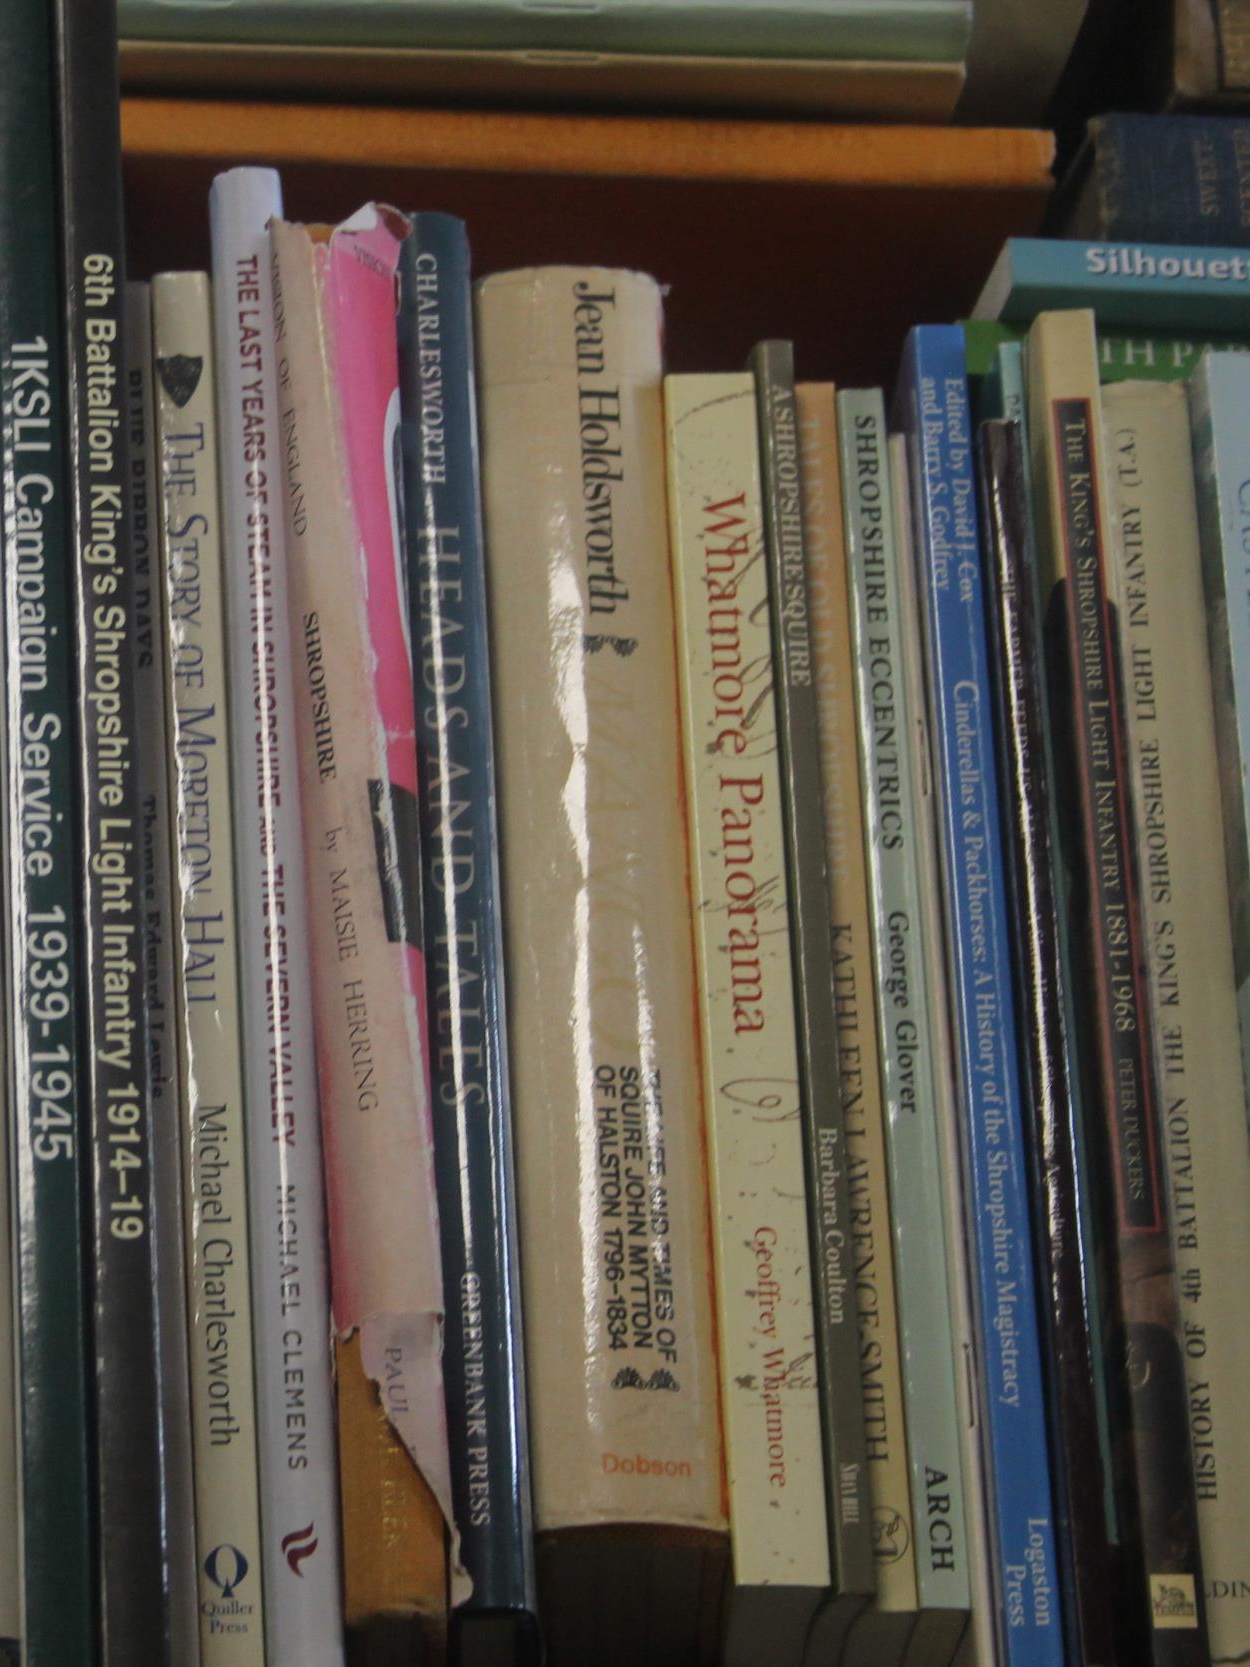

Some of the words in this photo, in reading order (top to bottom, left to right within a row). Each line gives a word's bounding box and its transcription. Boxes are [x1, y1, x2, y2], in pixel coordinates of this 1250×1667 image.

[82, 253, 115, 308] 6th
[236, 255, 260, 302] THE
[572, 281, 617, 378] Jean
[11, 335, 51, 441] 1KSLI
[237, 310, 264, 374] LAST
[277, 356, 293, 392] OF
[411, 252, 447, 486] CHARLESWORTH
[771, 384, 793, 403] A
[85, 318, 122, 472] Battalion
[240, 379, 268, 462] YEARS
[920, 377, 942, 416] and
[923, 420, 946, 474] Barry
[943, 378, 967, 441] Edited
[244, 470, 269, 505] OF
[281, 406, 313, 538] ENGLAND
[576, 385, 630, 616] Holdsworth
[774, 407, 807, 580] SHROPSHIRE
[945, 449, 965, 471] by
[951, 478, 974, 537] David
[246, 512, 273, 599] STEAM
[853, 415, 890, 617] SHROPSHIRE
[931, 505, 954, 591] Godfrey
[1119, 505, 1151, 627] INFANTRY
[12, 473, 57, 691] Campaign
[251, 606, 274, 634] IN
[416, 523, 470, 732] HEADS
[701, 492, 753, 755] Whatmore
[957, 562, 977, 603] Cox
[786, 584, 814, 687] SQUIRE
[1130, 643, 1156, 721] LIGHT
[89, 605, 131, 808] Shropshire
[252, 640, 283, 808] SHROPSHIRE
[300, 610, 338, 785] SHROPSHIRE
[868, 629, 905, 851] ECCENTRICS
[953, 680, 982, 805] Cinderellas
[21, 712, 64, 876] Service
[320, 825, 343, 854] by
[429, 754, 477, 897] AND
[963, 811, 981, 829] &
[1136, 739, 1172, 903] SHROPSHIRE
[91, 817, 135, 913] Light
[260, 863, 287, 917] THE
[329, 866, 358, 963] MAISIE
[717, 776, 774, 1037] Panorama
[964, 836, 993, 963] Packhorses:
[97, 924, 142, 1070] Infantry
[263, 923, 292, 1035] SEVERN
[884, 910, 915, 1009] George
[974, 970, 992, 986] A
[1105, 902, 1136, 1032] 1881-1968
[27, 905, 74, 1161] 1939-1945
[343, 978, 379, 1111] HERRING
[432, 917, 487, 1111] TALES
[974, 993, 999, 1074] History
[1162, 1026, 1186, 1075] THE
[268, 1041, 298, 1149] VALLEY
[594, 1064, 618, 1104] OF
[618, 1065, 646, 1164] SQUIRE
[893, 1019, 922, 1114] Glover
[981, 1081, 1007, 1103] of
[1118, 1058, 1140, 1111] PETER
[197, 1103, 233, 1225] Michael
[597, 1107, 626, 1219] HALSTON
[816, 1127, 844, 1226] Barbara
[984, 1109, 1009, 1145] the
[1168, 1097, 1200, 1250] BATTALION
[276, 1184, 301, 1316] MICHAEL
[624, 1166, 650, 1239] JOHN
[984, 1150, 1014, 1274] Shropshire
[628, 1244, 655, 1350] MYTTON
[747, 1226, 786, 1340] Geoffrey
[822, 1229, 848, 1326] Coulton
[203, 1239, 241, 1446] Charlesworth
[382, 1346, 411, 1425] PAUL
[459, 1270, 489, 1437] GREENBANK
[656, 1328, 678, 1365] OF
[993, 1281, 1022, 1408] Magistracy
[1184, 1320, 1208, 1359] OF
[281, 1328, 309, 1470] CLEMENS
[757, 1346, 791, 1489] Whatmore
[1189, 1380, 1220, 1502] HISTORY
[467, 1446, 493, 1528] PRESS
[601, 1453, 692, 1478] Dobson
[924, 1465, 956, 1574] ARCH
[1005, 1563, 1028, 1627] Press
[1023, 1517, 1053, 1627] Logaston
